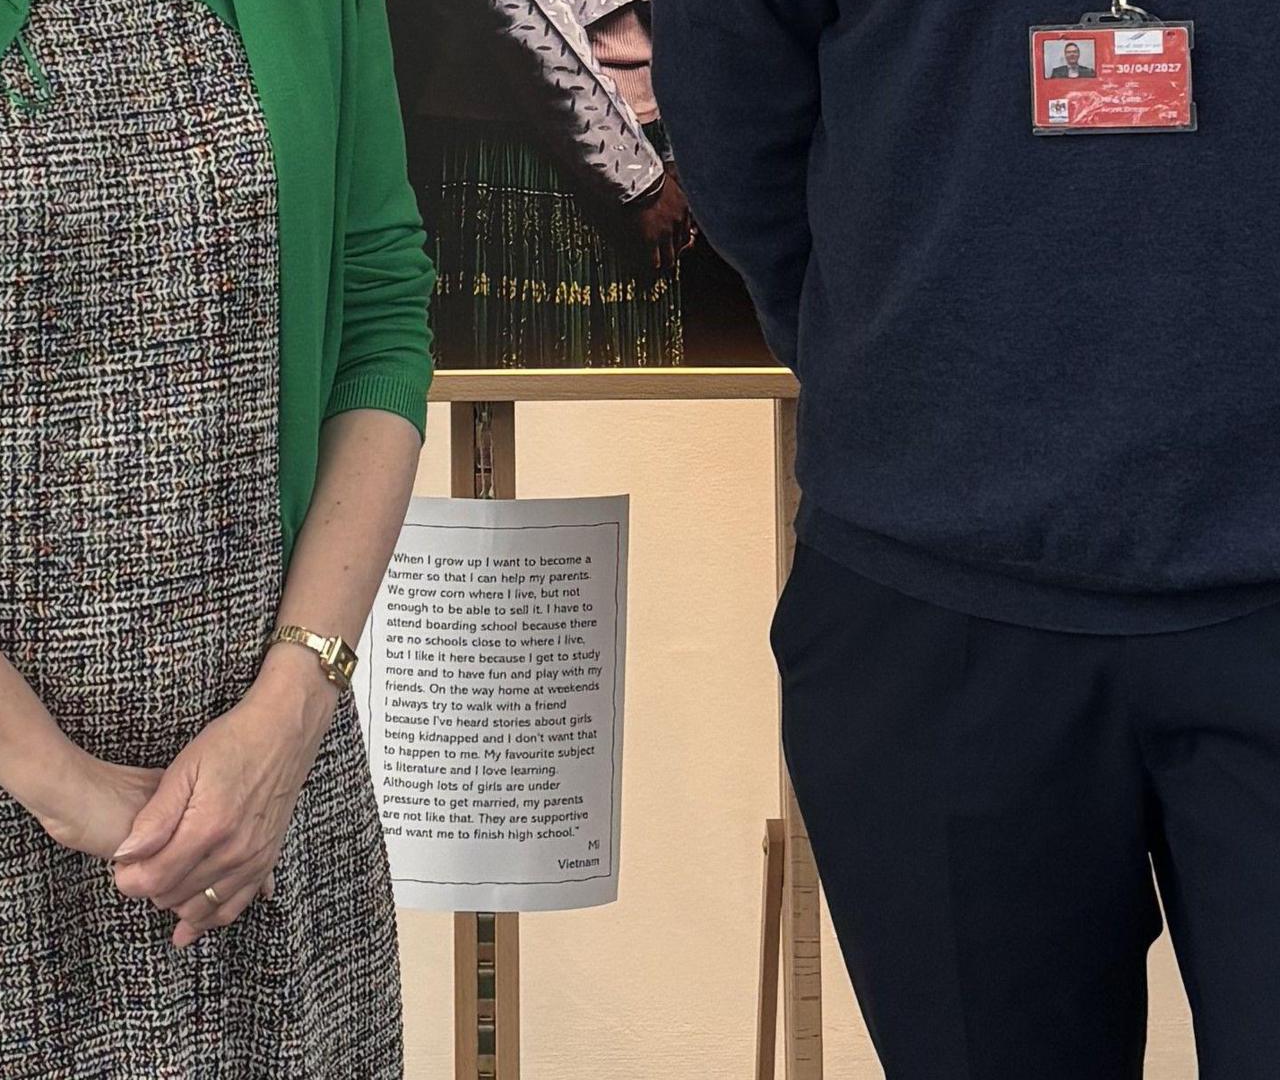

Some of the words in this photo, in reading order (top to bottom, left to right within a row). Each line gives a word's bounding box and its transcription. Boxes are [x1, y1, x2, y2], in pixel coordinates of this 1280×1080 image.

[1115, 63, 1182, 75] 30/04/2027
[434, 557, 464, 568] grow
[467, 559, 482, 570] up
[493, 558, 520, 568] want
[524, 557, 536, 567] to
[540, 555, 582, 567] become
[585, 556, 591, 564] a
[427, 573, 440, 582] so
[444, 571, 466, 583] that
[477, 573, 497, 584] can
[501, 571, 526, 586] help
[529, 574, 545, 585] my
[387, 583, 405, 596] We
[408, 583, 437, 599] grow
[440, 585, 465, 599] corn
[469, 588, 504, 600] where
[541, 584, 559, 599] but
[563, 583, 580, 598] not
[387, 600, 429, 615] enough
[432, 604, 444, 614] to
[448, 603, 463, 615] be
[466, 604, 491, 616] able
[494, 606, 506, 616] to
[510, 604, 529, 616] sell
[554, 599, 579, 614] have
[582, 602, 593, 612] to
[387, 617, 422, 629] attend
[426, 616, 477, 634] boarding
[481, 620, 517, 632] school
[522, 620, 567, 632] because
[570, 618, 597, 629] there
[386, 634, 404, 644] are
[407, 631, 422, 646] no
[425, 632, 468, 647] schools
[471, 636, 501, 648] close
[505, 637, 517, 648] to
[520, 635, 554, 647] where
[558, 856, 601, 870] Vietnam
